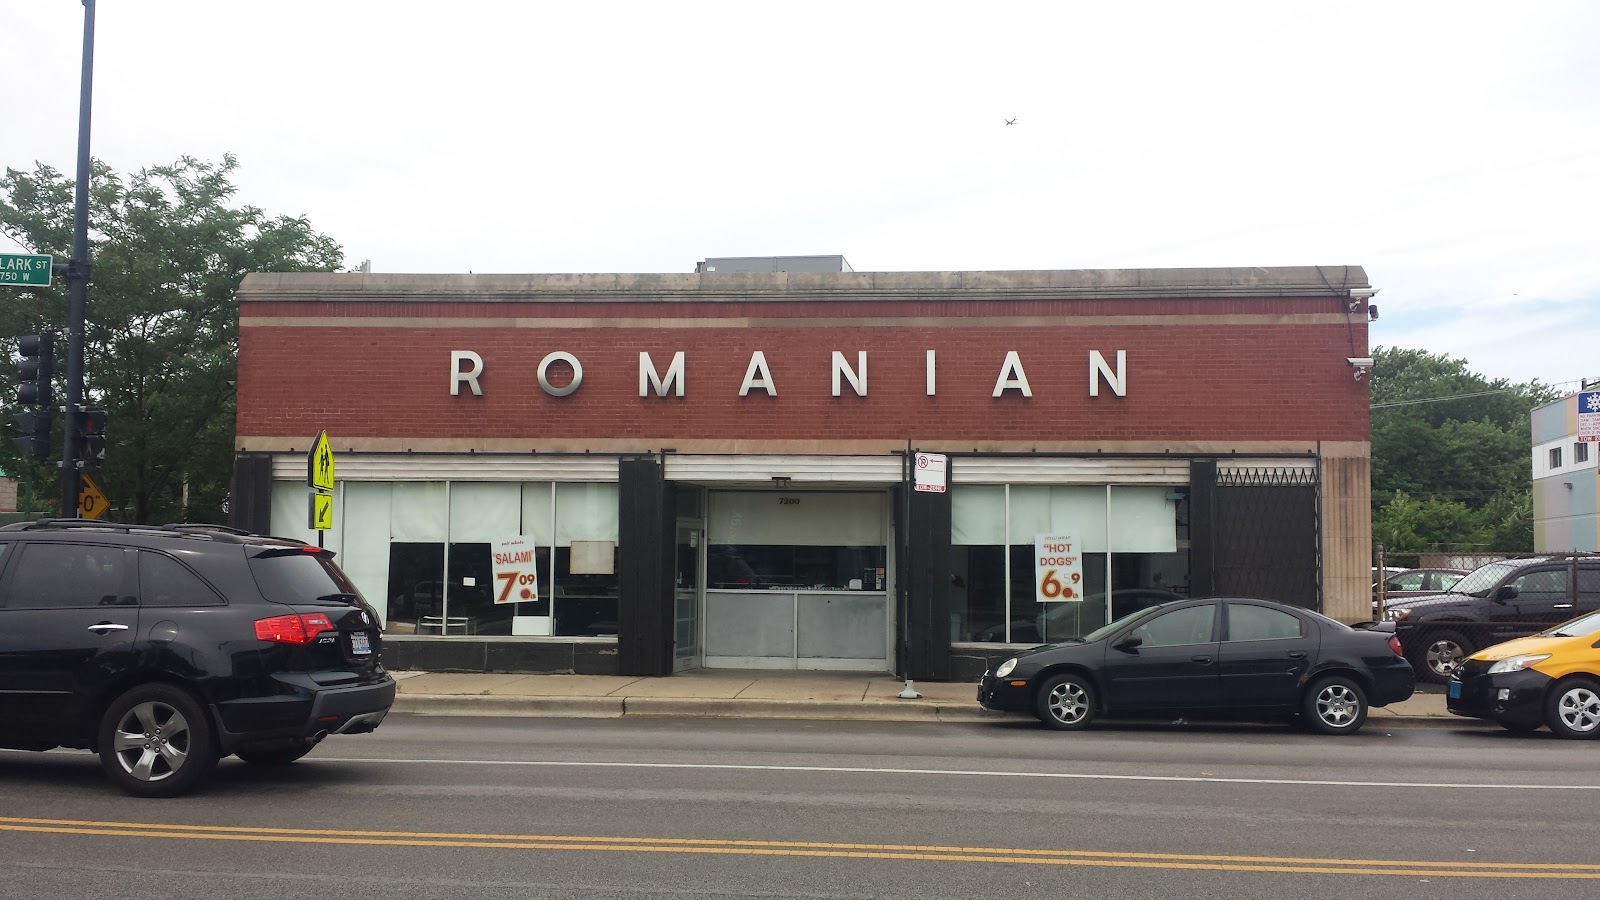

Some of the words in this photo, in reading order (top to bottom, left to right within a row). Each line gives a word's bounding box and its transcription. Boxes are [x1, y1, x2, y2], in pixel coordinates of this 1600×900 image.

[36, 260, 47, 269] ST
[22, 272, 30, 281] W
[450, 350, 1127, 398] ROMANIAN
